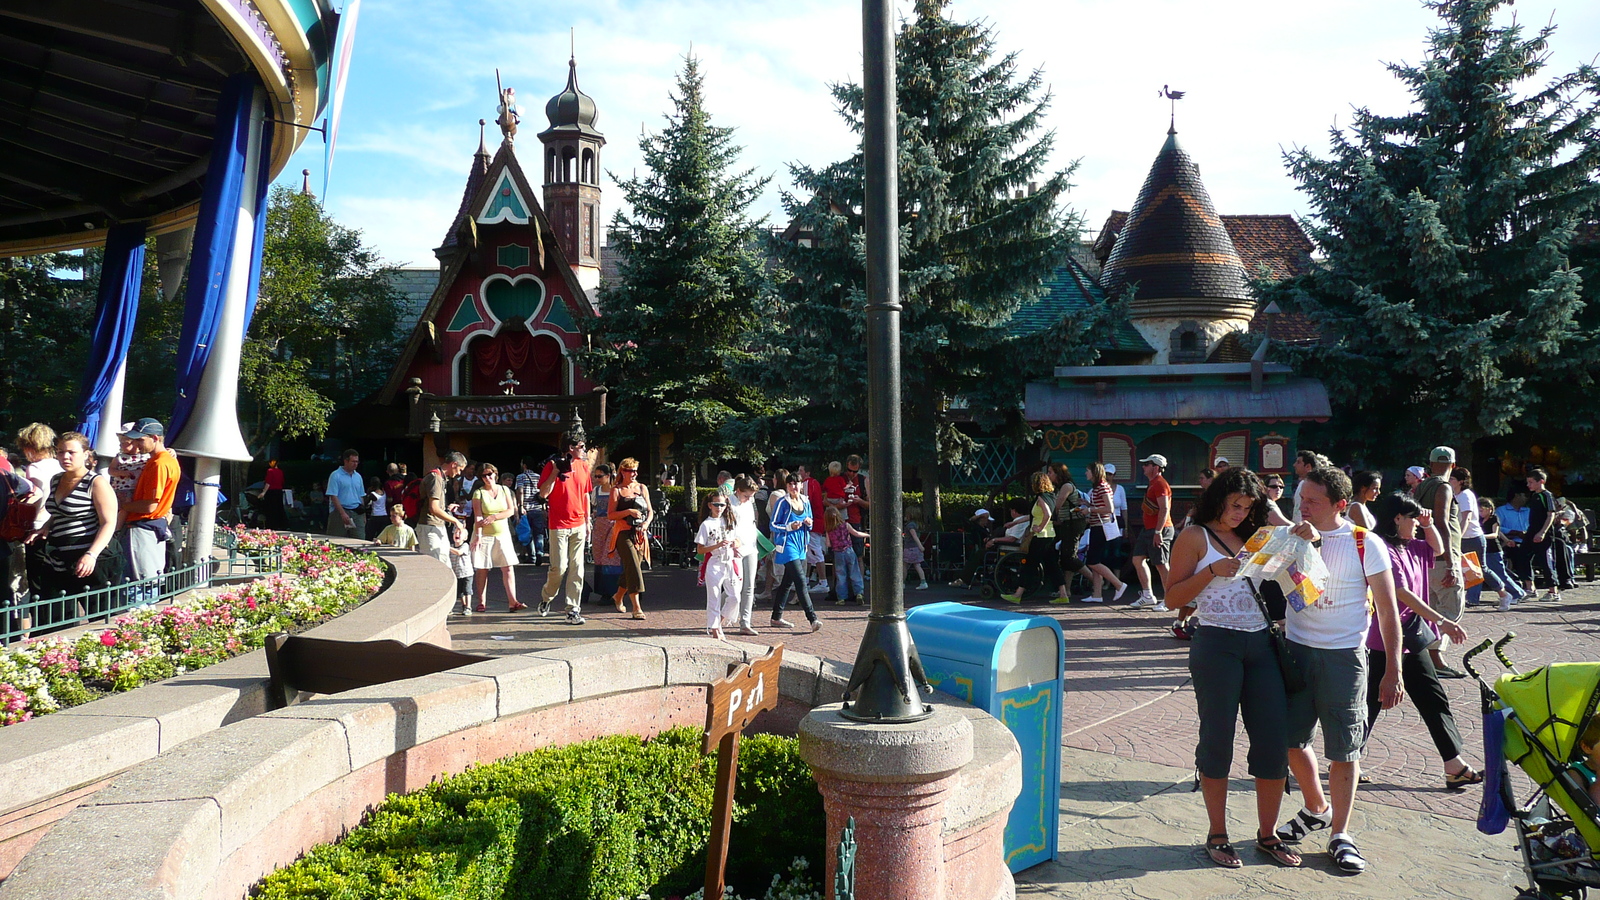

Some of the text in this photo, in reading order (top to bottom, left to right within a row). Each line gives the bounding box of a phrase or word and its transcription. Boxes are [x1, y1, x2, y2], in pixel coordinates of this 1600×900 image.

[454, 407, 561, 426] PINOCCHIO
[484, 401, 536, 414] VOYAGES
[727, 688, 743, 727] P
